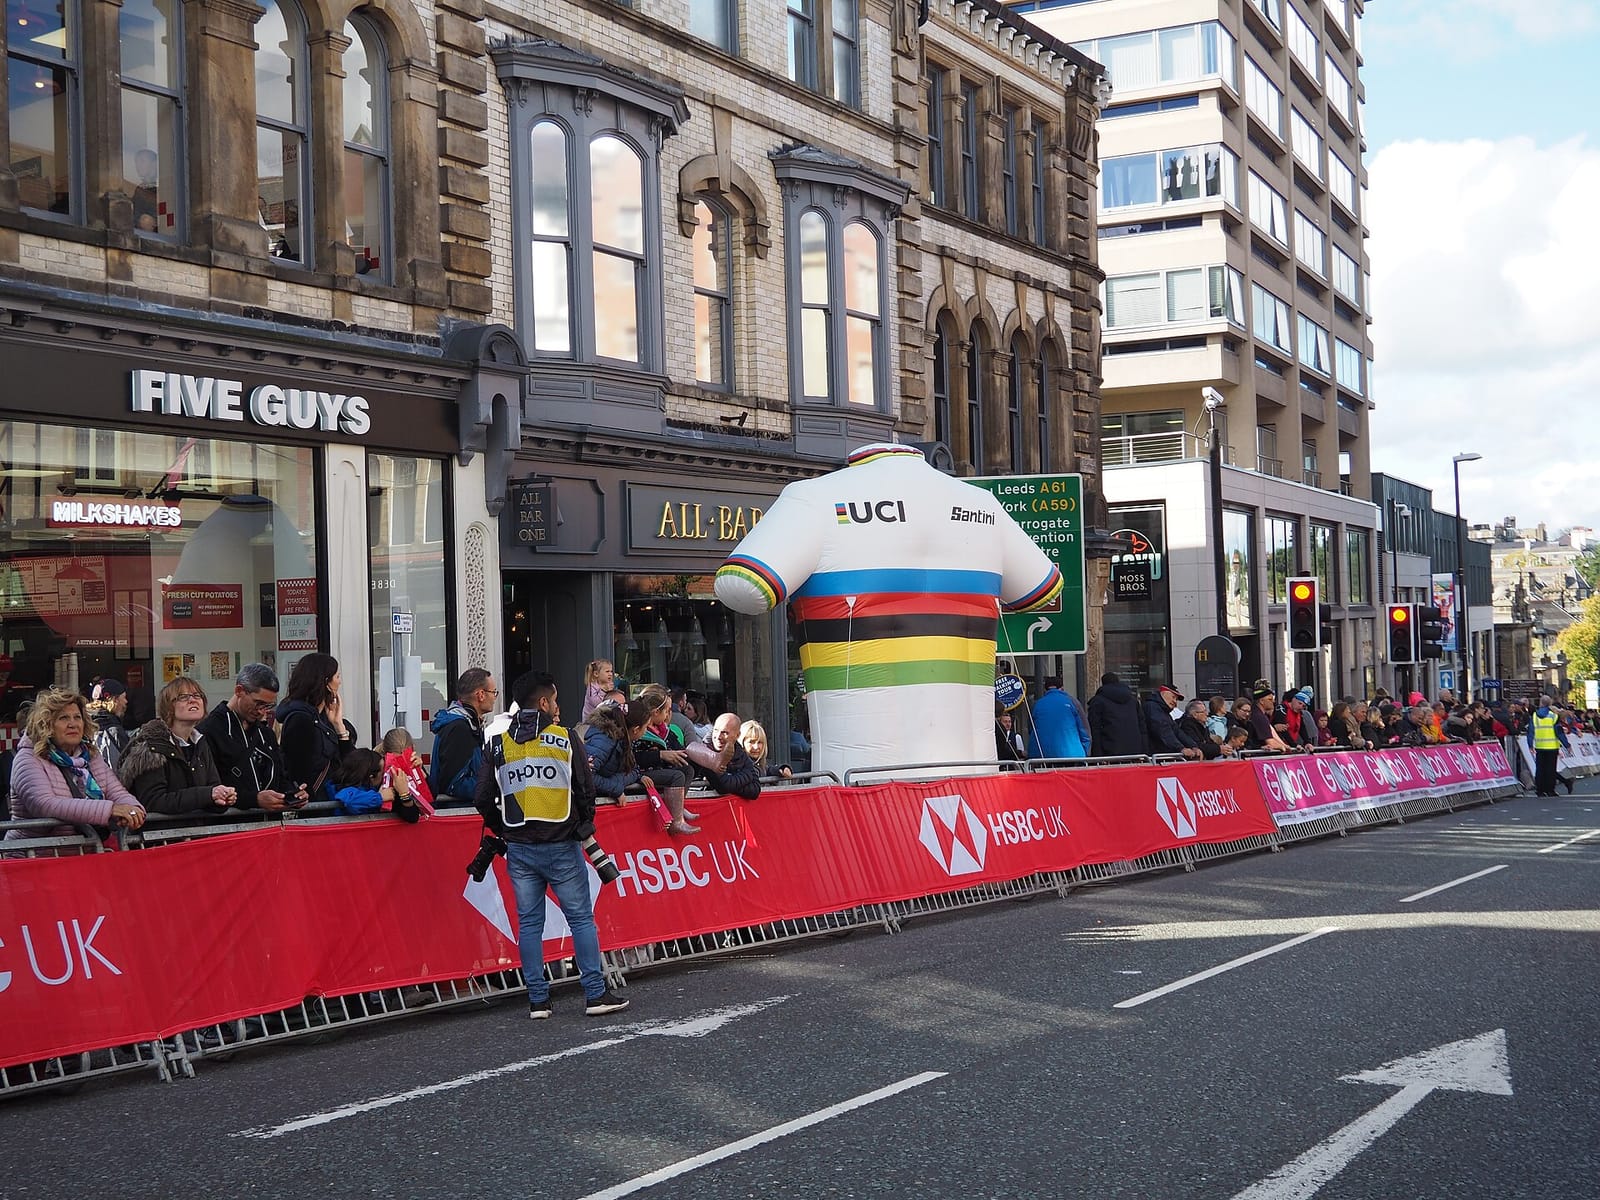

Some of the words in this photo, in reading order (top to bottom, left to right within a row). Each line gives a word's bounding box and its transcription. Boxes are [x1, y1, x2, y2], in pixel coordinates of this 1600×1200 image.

[132, 369, 243, 421] FIVE
[250, 384, 370, 435] GUYS
[998, 483, 1035, 495] Leeds
[1040, 481, 1066, 494] A61
[520, 492, 542, 505] ALL
[1031, 497, 1076, 512] (A59)
[53, 501, 182, 526] MILKSHAKES
[520, 510, 544, 522] BAR
[657, 501, 709, 538] ALL
[849, 500, 906, 524] UCI
[951, 506, 996, 526] Santini
[519, 528, 546, 541] ONE
[1119, 574, 1145, 582] MOSS
[167, 591, 189, 599] FRESH
[190, 591, 204, 599] CUT
[205, 591, 239, 599] POTATOES
[546, 734, 569, 750] UCI
[507, 764, 557, 785] PHOTO
[1193, 789, 1226, 818] HSBC
[1221, 788, 1242, 813] UK
[987, 808, 1044, 847] HSBC
[1040, 805, 1071, 838] UK
[608, 844, 710, 897] HSBC
[709, 839, 760, 883] UK
[21, 915, 122, 985] UK
